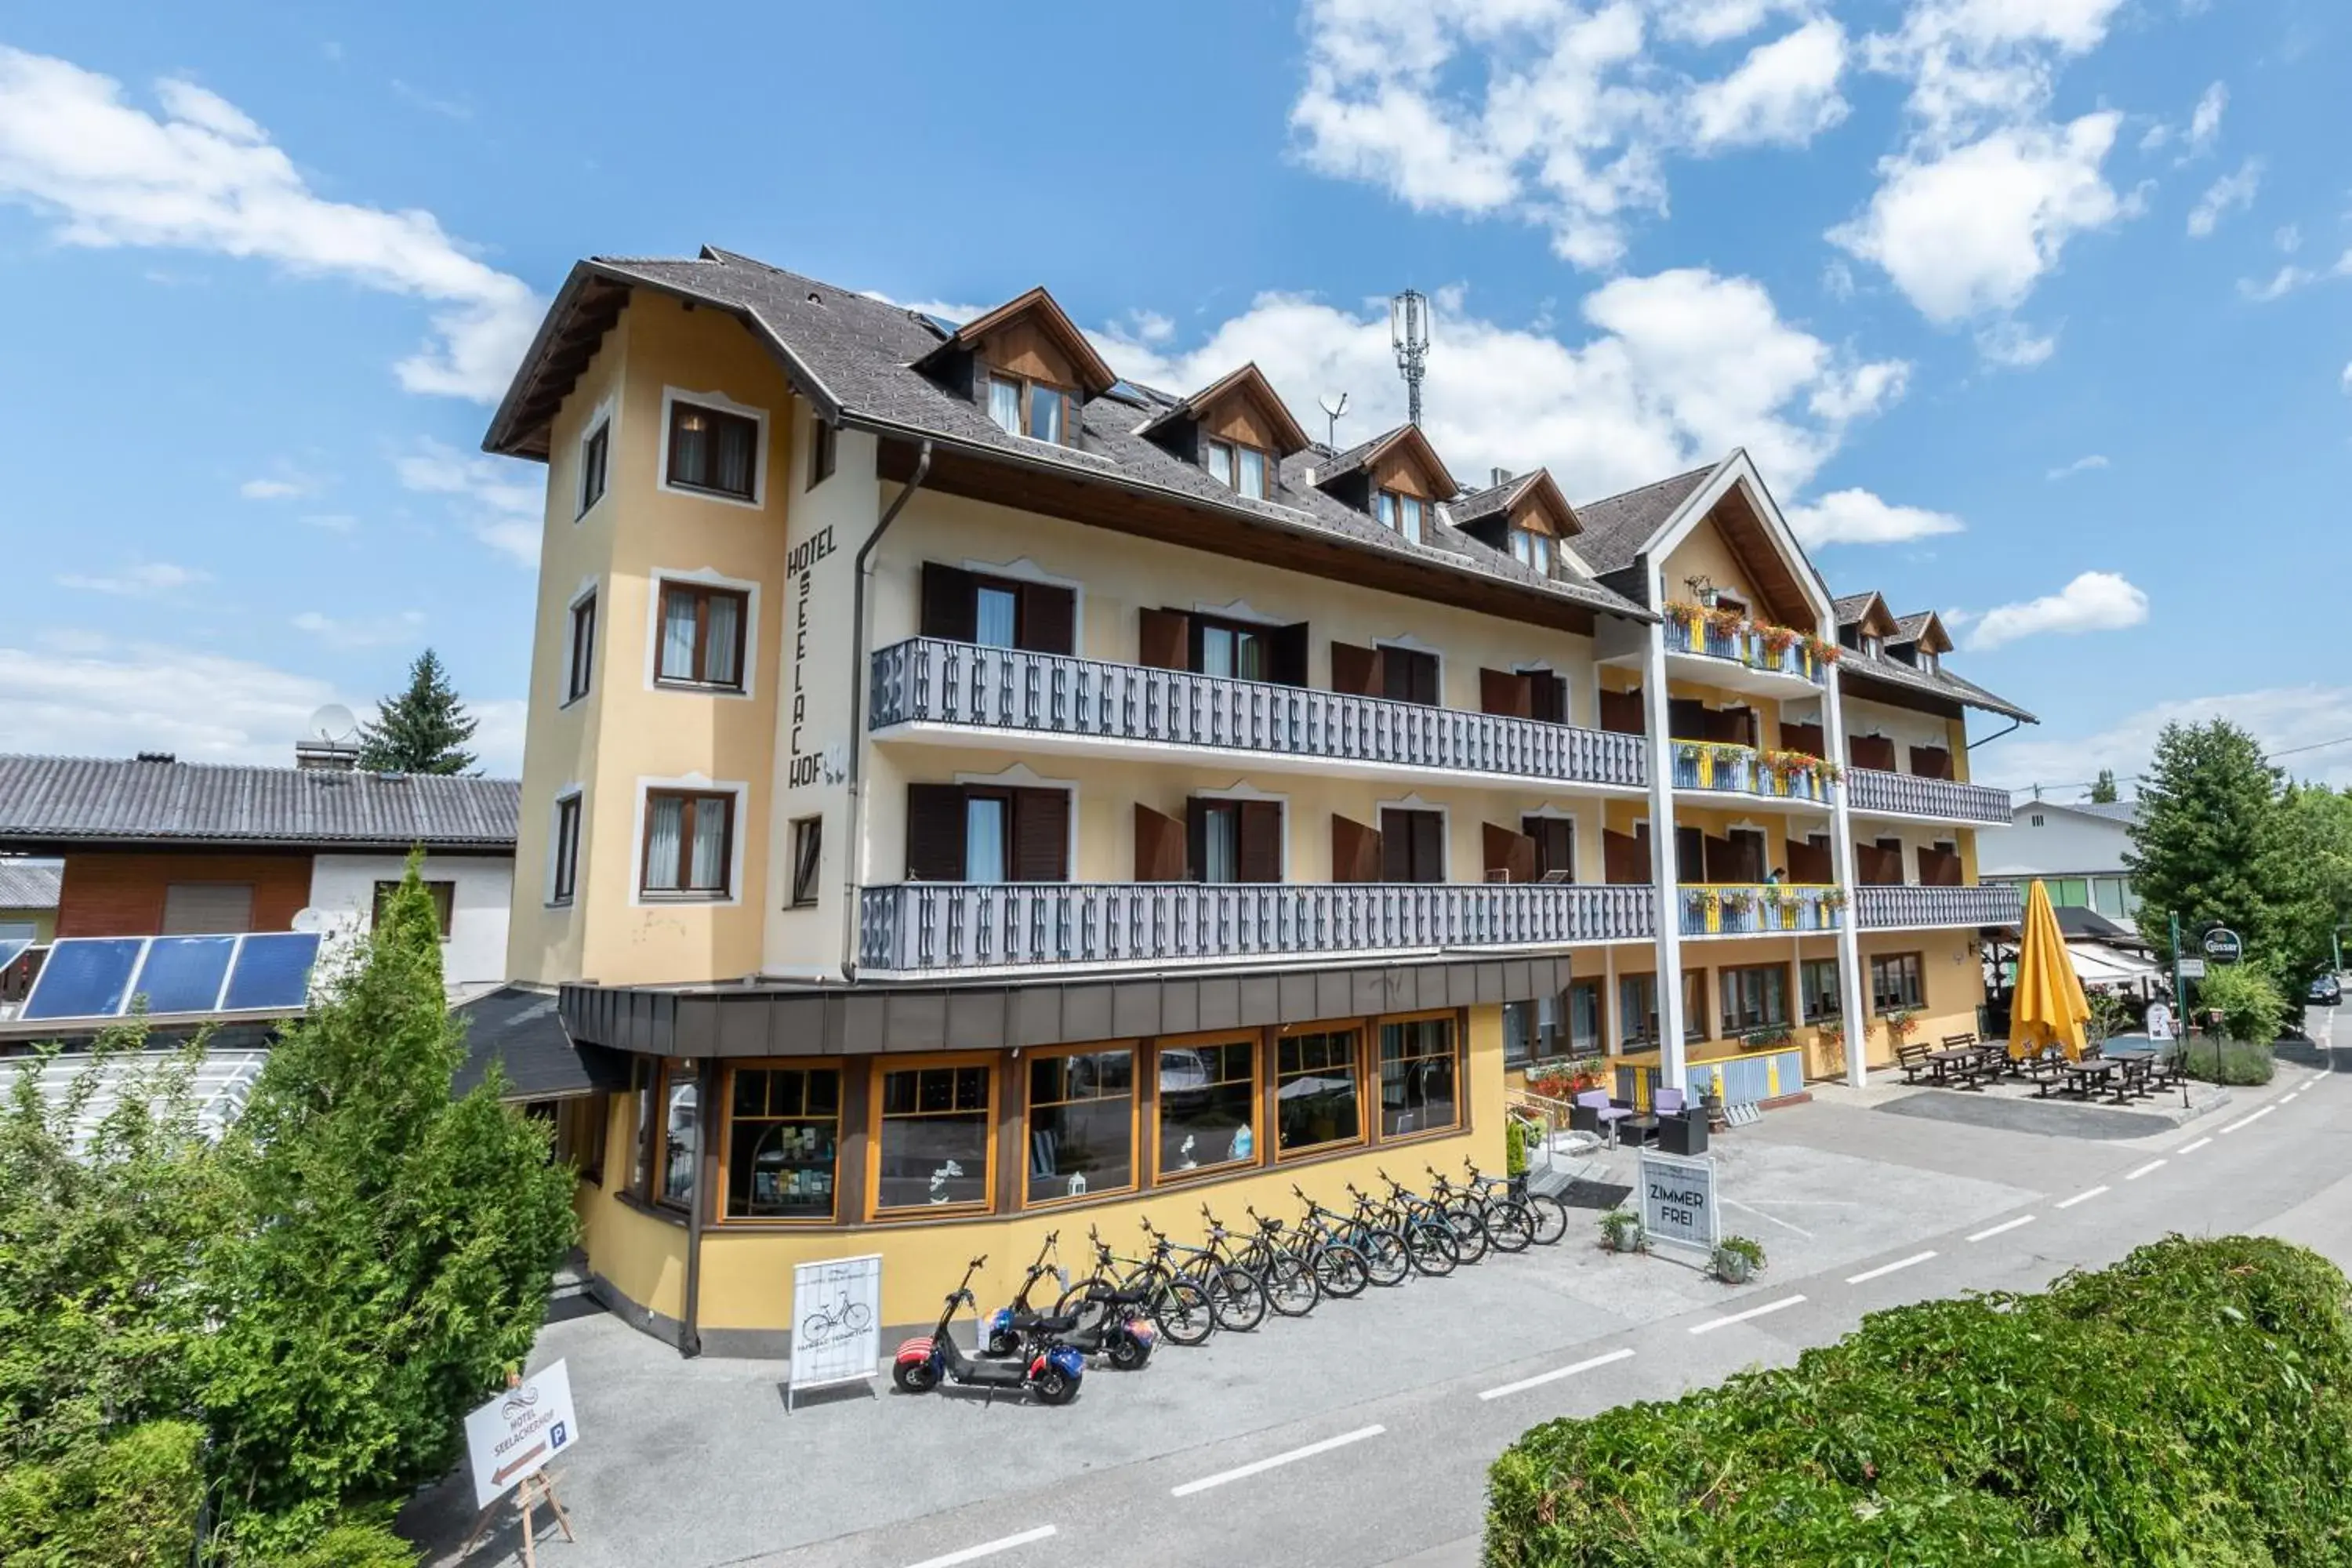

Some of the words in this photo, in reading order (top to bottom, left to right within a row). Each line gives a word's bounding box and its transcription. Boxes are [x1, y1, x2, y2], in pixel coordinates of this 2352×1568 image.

[787, 524, 837, 579] HOTEL
[789, 750, 823, 789] HOF
[1650, 1183, 1704, 1209] ZIMMER
[1661, 1206, 1693, 1227] FREI
[510, 1408, 537, 1432] HOTEL
